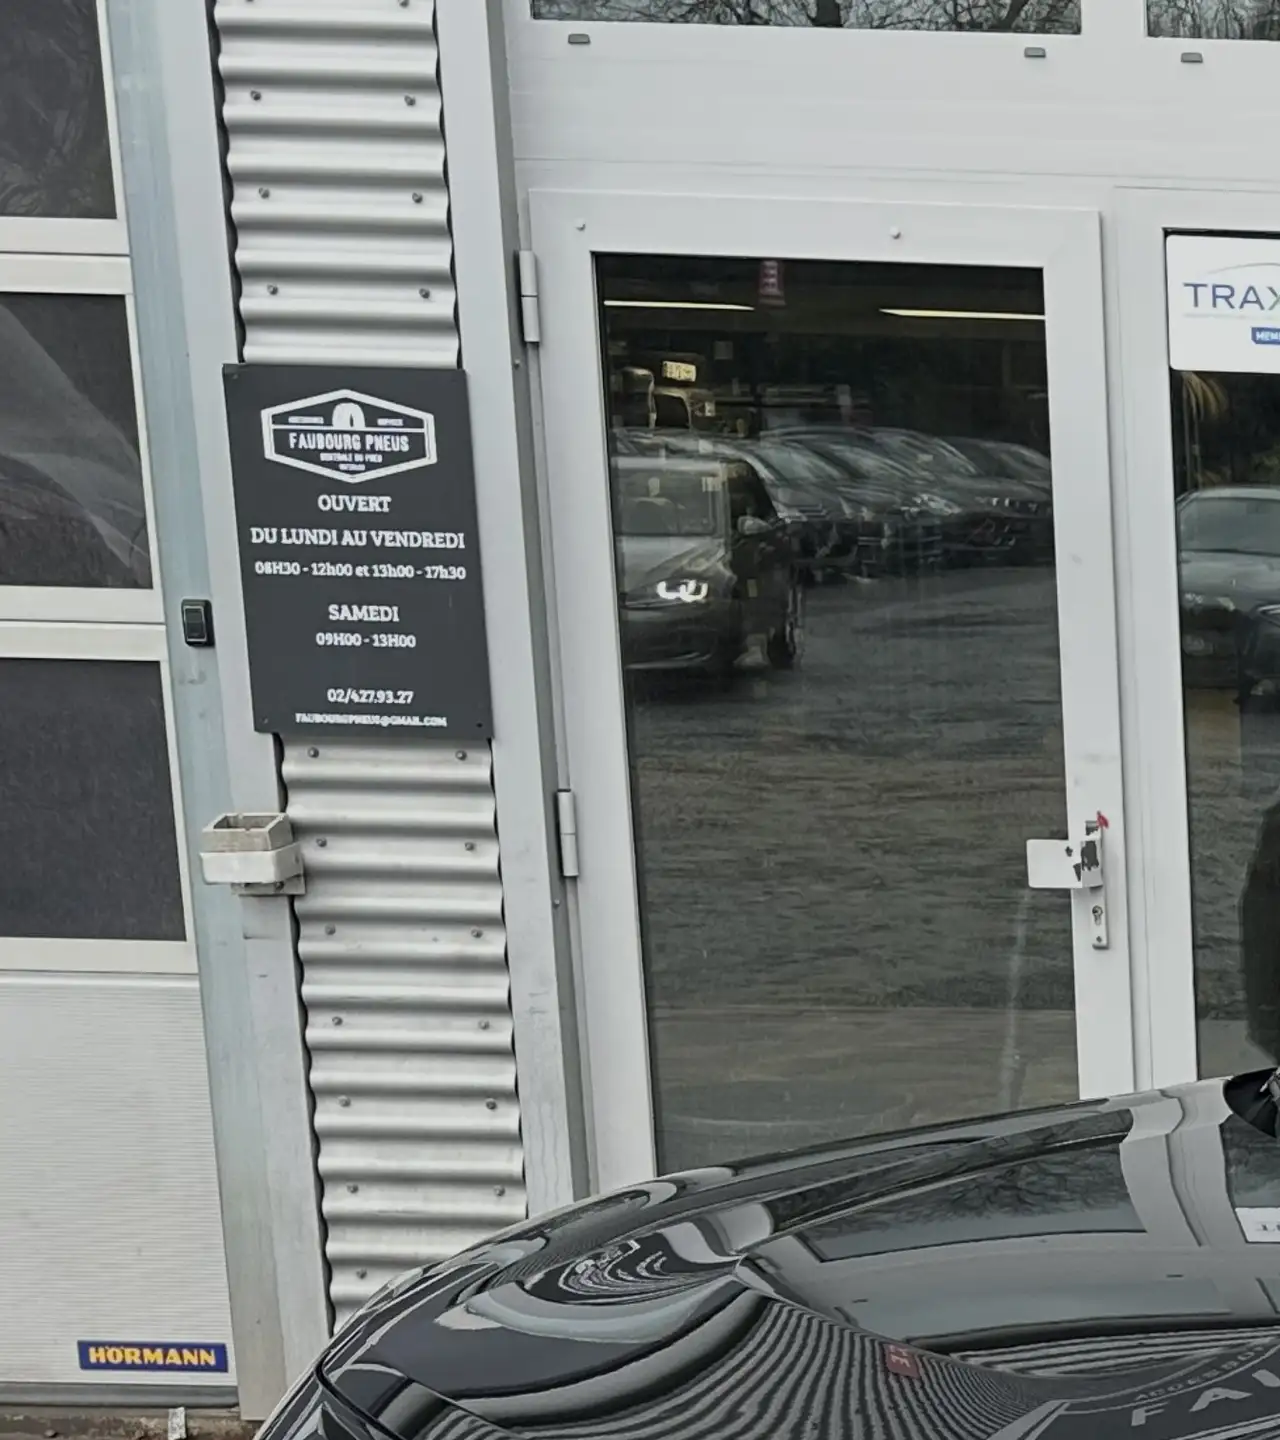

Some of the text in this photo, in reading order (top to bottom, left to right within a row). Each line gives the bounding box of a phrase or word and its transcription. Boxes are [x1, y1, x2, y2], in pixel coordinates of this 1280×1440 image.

[288, 432, 410, 452] FAUBOURG PNEUS
[318, 494, 392, 512] OUVERT
[250, 527, 465, 548] DU LUNDI AU VENDREDI
[255, 561, 300, 575] 08H30
[311, 562, 353, 577] 12h00
[355, 564, 370, 577] et
[372, 563, 414, 578] 13h00
[424, 565, 467, 580] 17h30
[328, 604, 400, 622] SAMEDI
[316, 632, 362, 647] 09H00
[372, 633, 416, 648] 13H00
